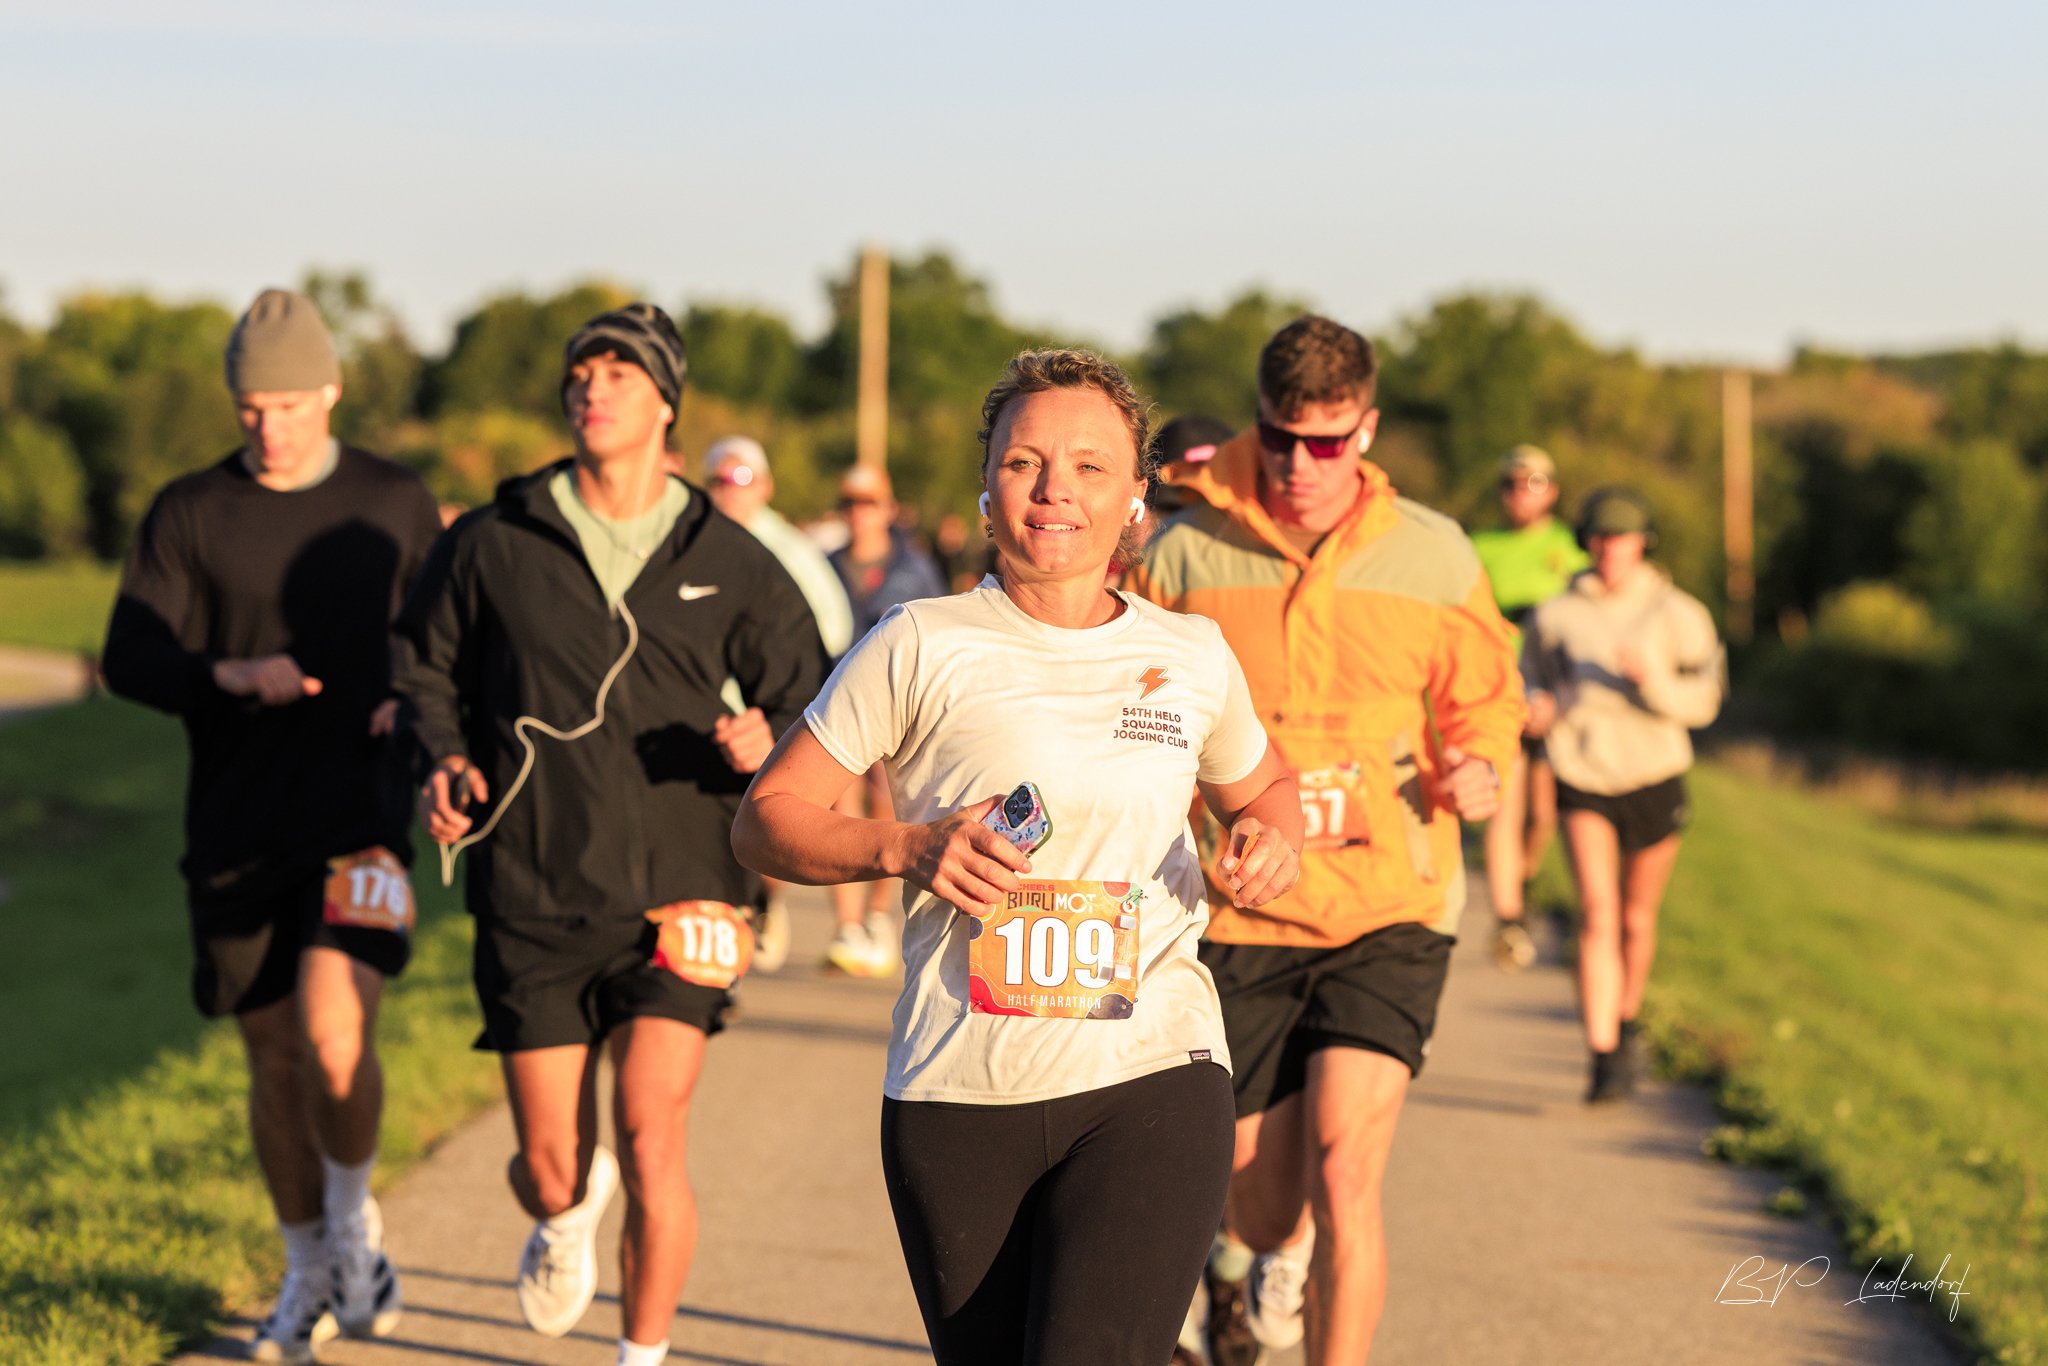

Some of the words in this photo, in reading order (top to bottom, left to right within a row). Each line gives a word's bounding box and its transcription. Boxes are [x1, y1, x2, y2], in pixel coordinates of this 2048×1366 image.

[1122, 707, 1152, 719] 54TH
[1155, 710, 1181, 723] HELO
[1121, 719, 1182, 735] SQUADRON
[1113, 729, 1165, 743] JOGGING
[1167, 736, 1188, 749] CLUB
[1298, 789, 1346, 838] 57
[1017, 883, 1055, 892] CHEELS
[676, 915, 738, 967] 178
[995, 916, 1115, 989] 109
[1007, 994, 1036, 1006] HALF
[1040, 995, 1101, 1009] MARATHON
